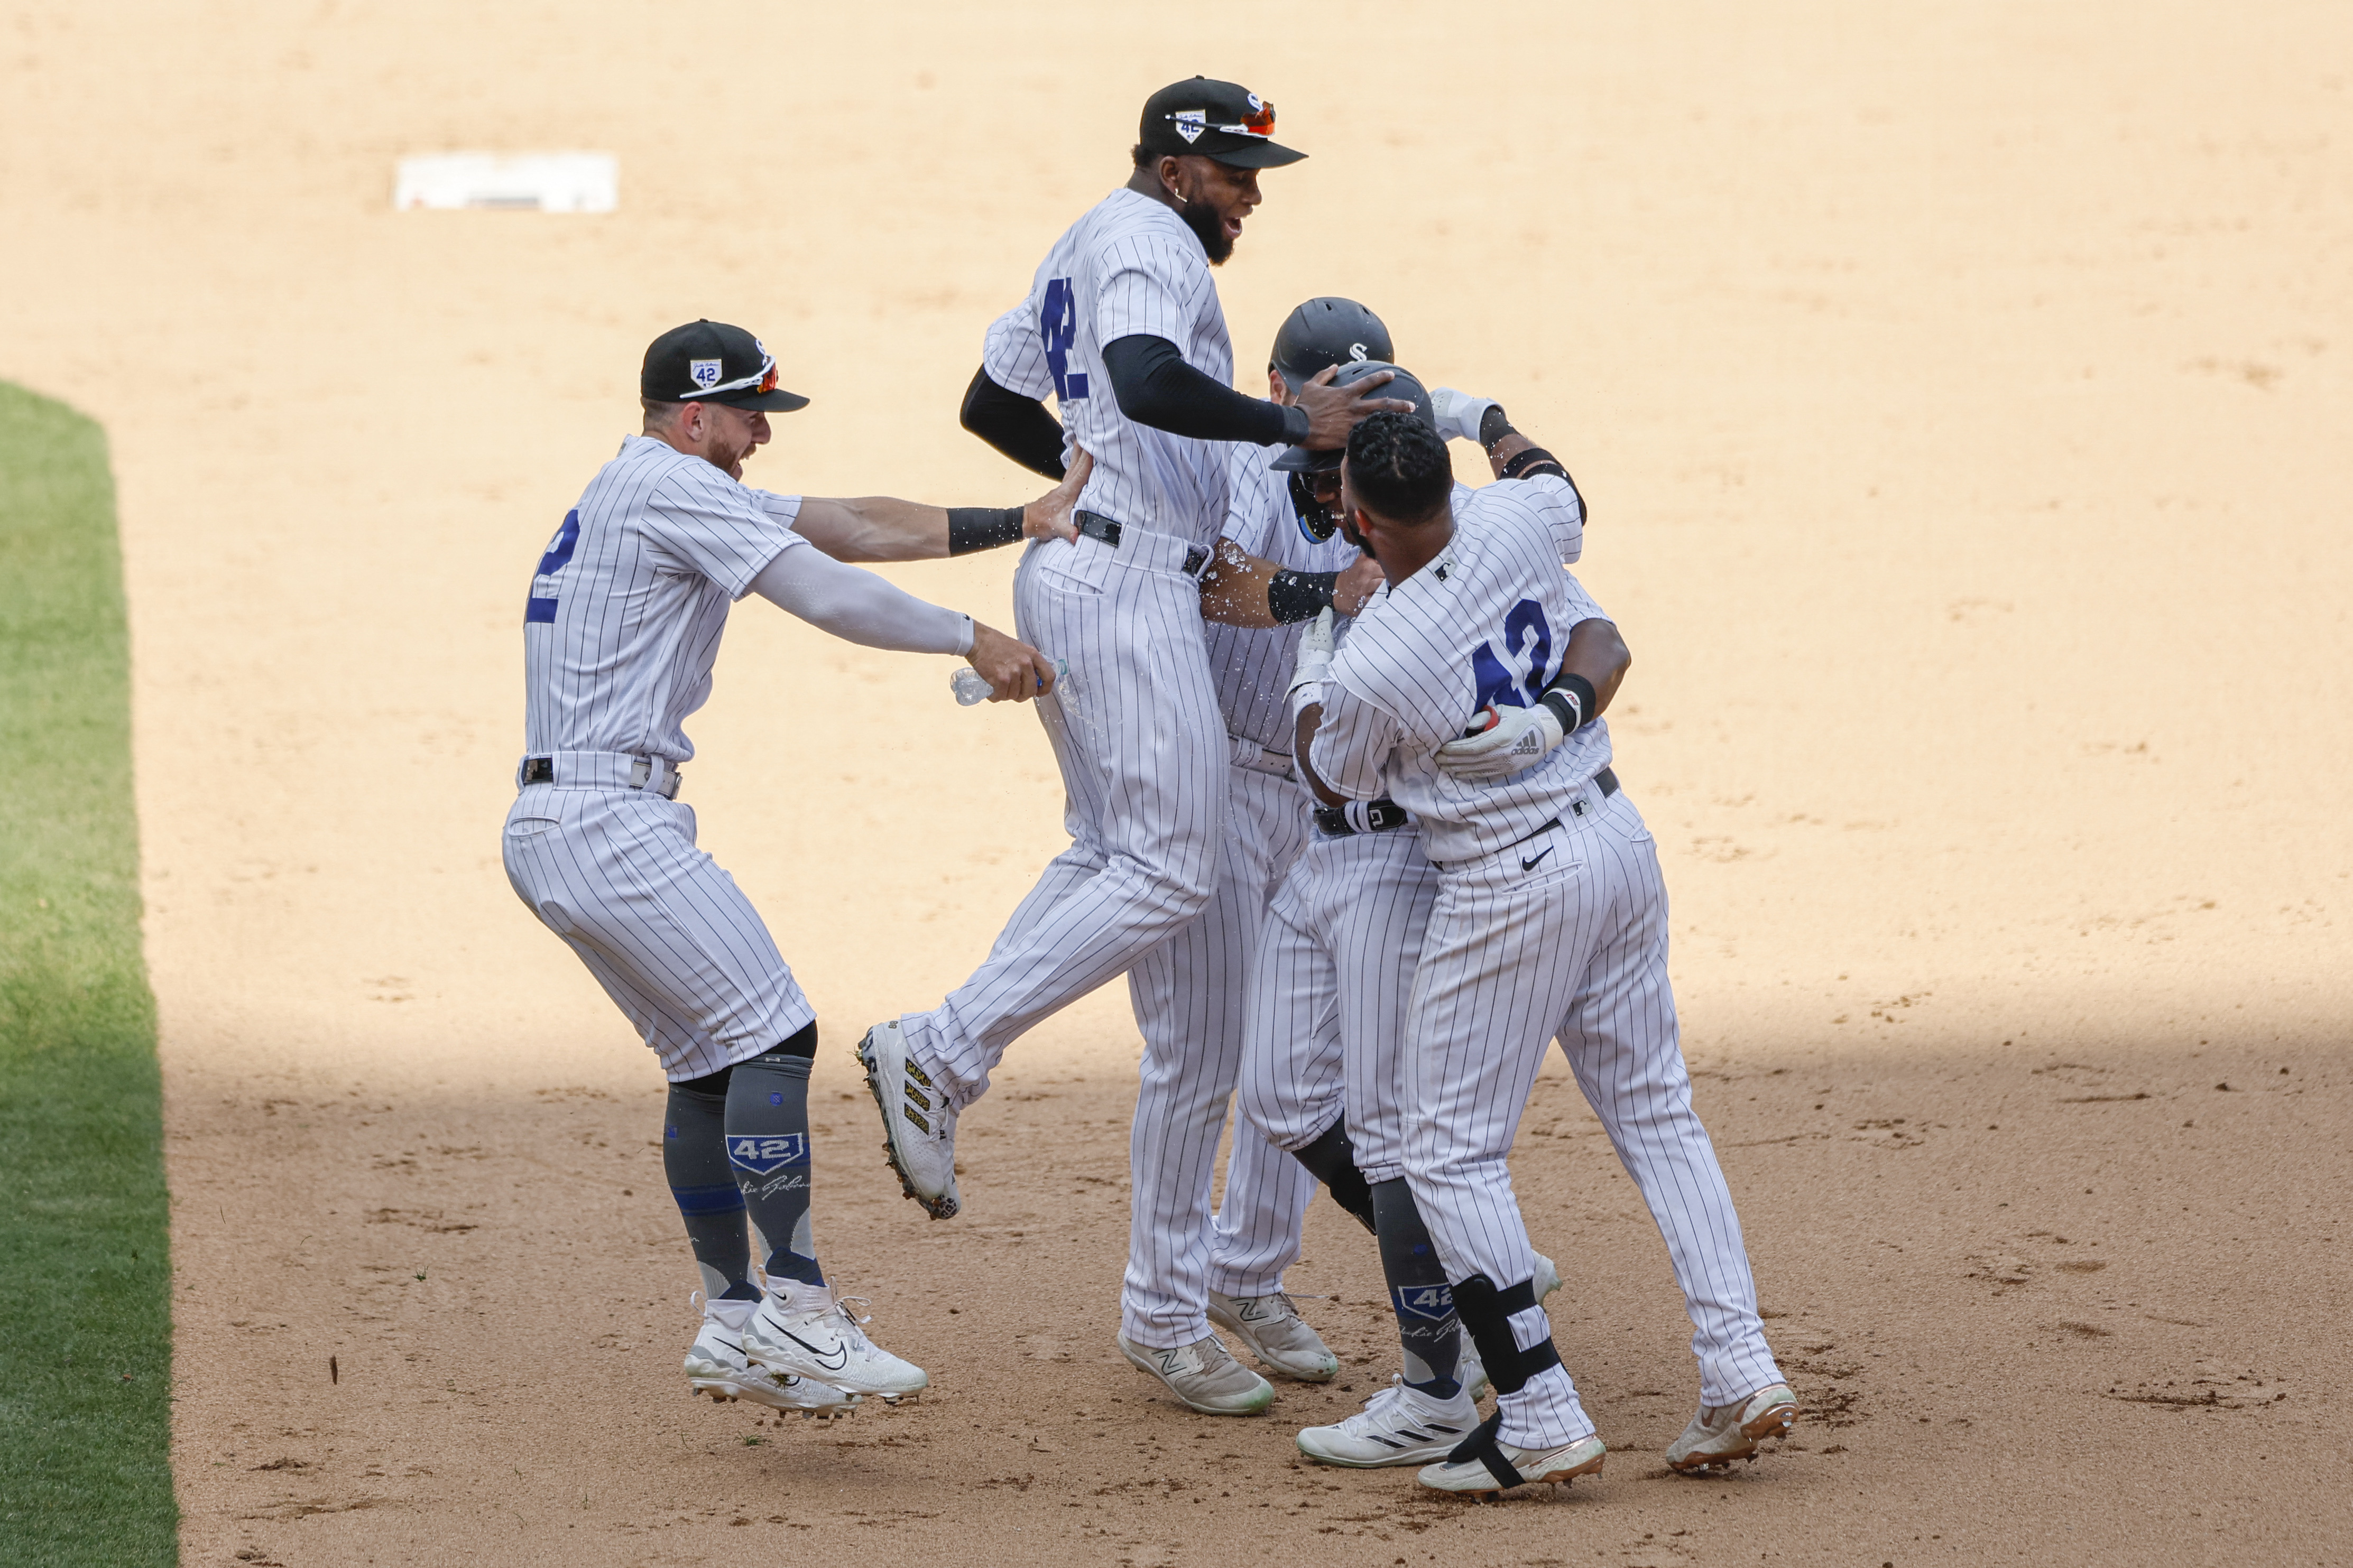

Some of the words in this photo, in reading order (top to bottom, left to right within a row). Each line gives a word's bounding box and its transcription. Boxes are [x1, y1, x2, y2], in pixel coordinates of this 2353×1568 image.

[1181, 119, 1199, 133] 42
[696, 368, 715, 382] 42
[1511, 746, 1539, 755] adidas
[734, 1139, 791, 1159] 42
